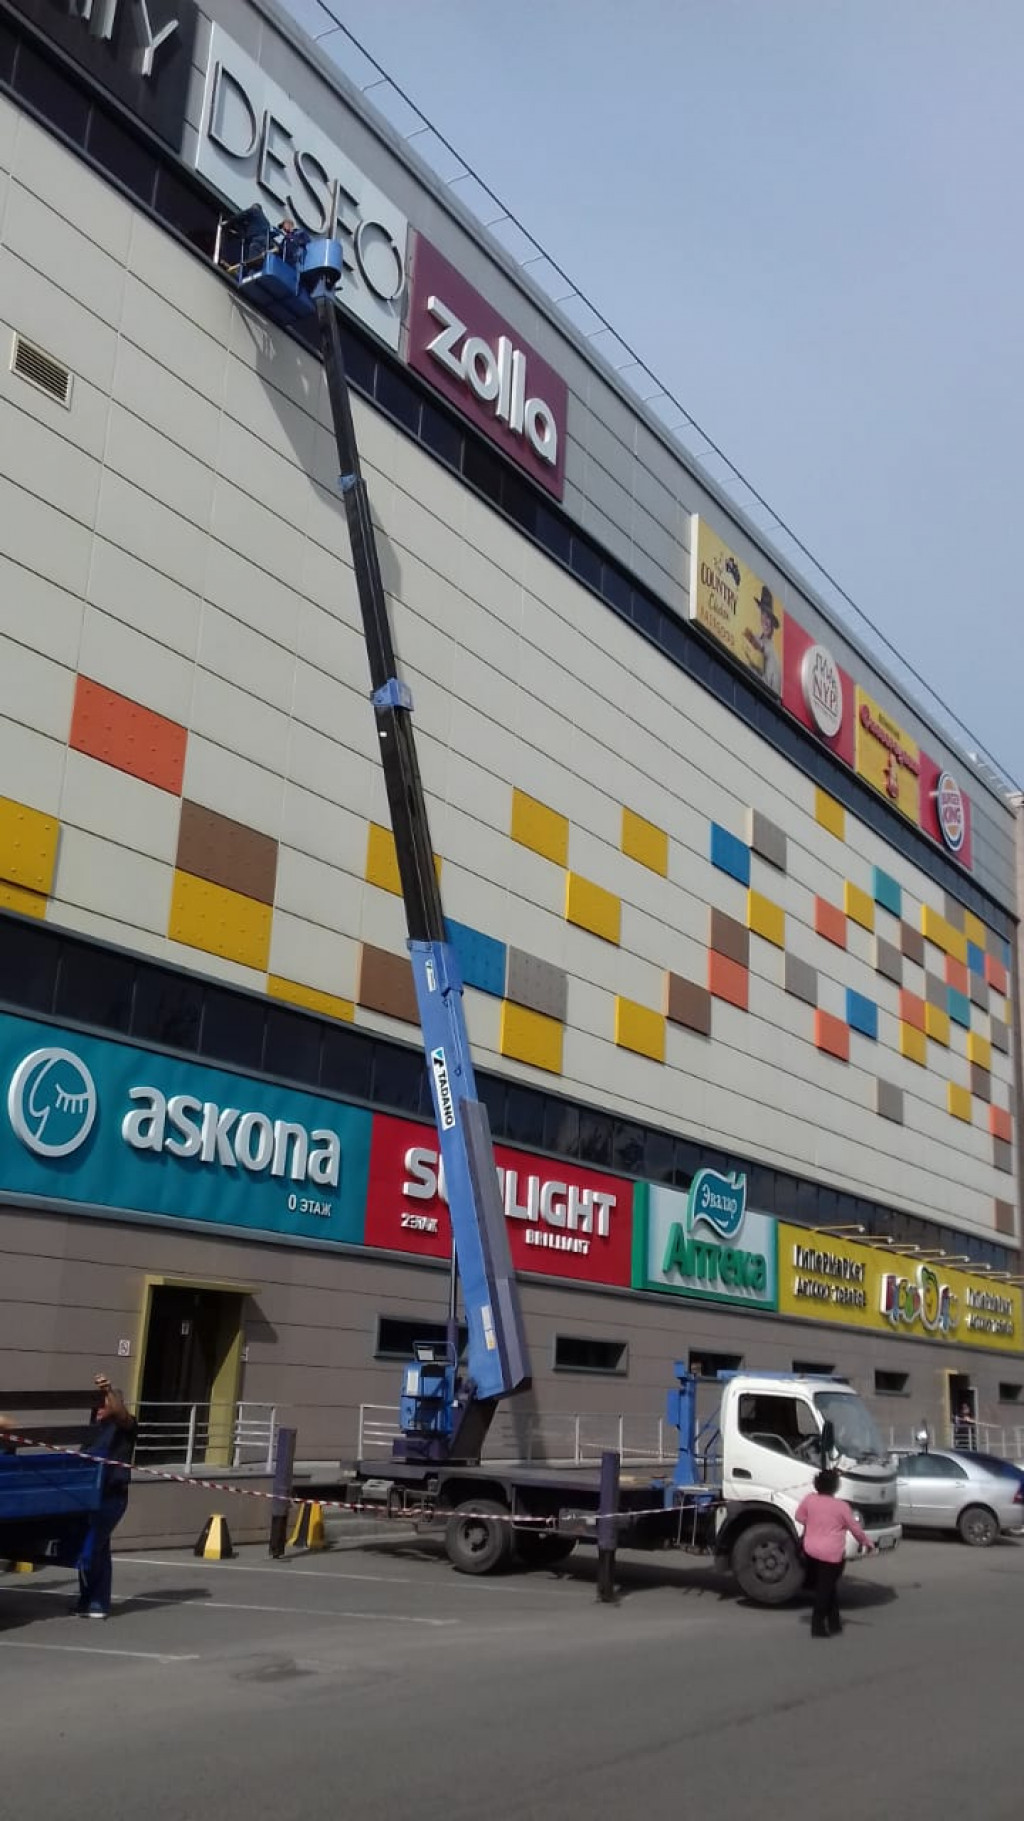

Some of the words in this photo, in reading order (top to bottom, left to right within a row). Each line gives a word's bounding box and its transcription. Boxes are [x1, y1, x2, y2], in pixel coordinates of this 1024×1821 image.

[207, 60, 406, 301] DESEO
[121, 1086, 341, 1187] askona
[437, 1070, 454, 1127] TADANO
[403, 1147, 617, 1237] SLIGHT
